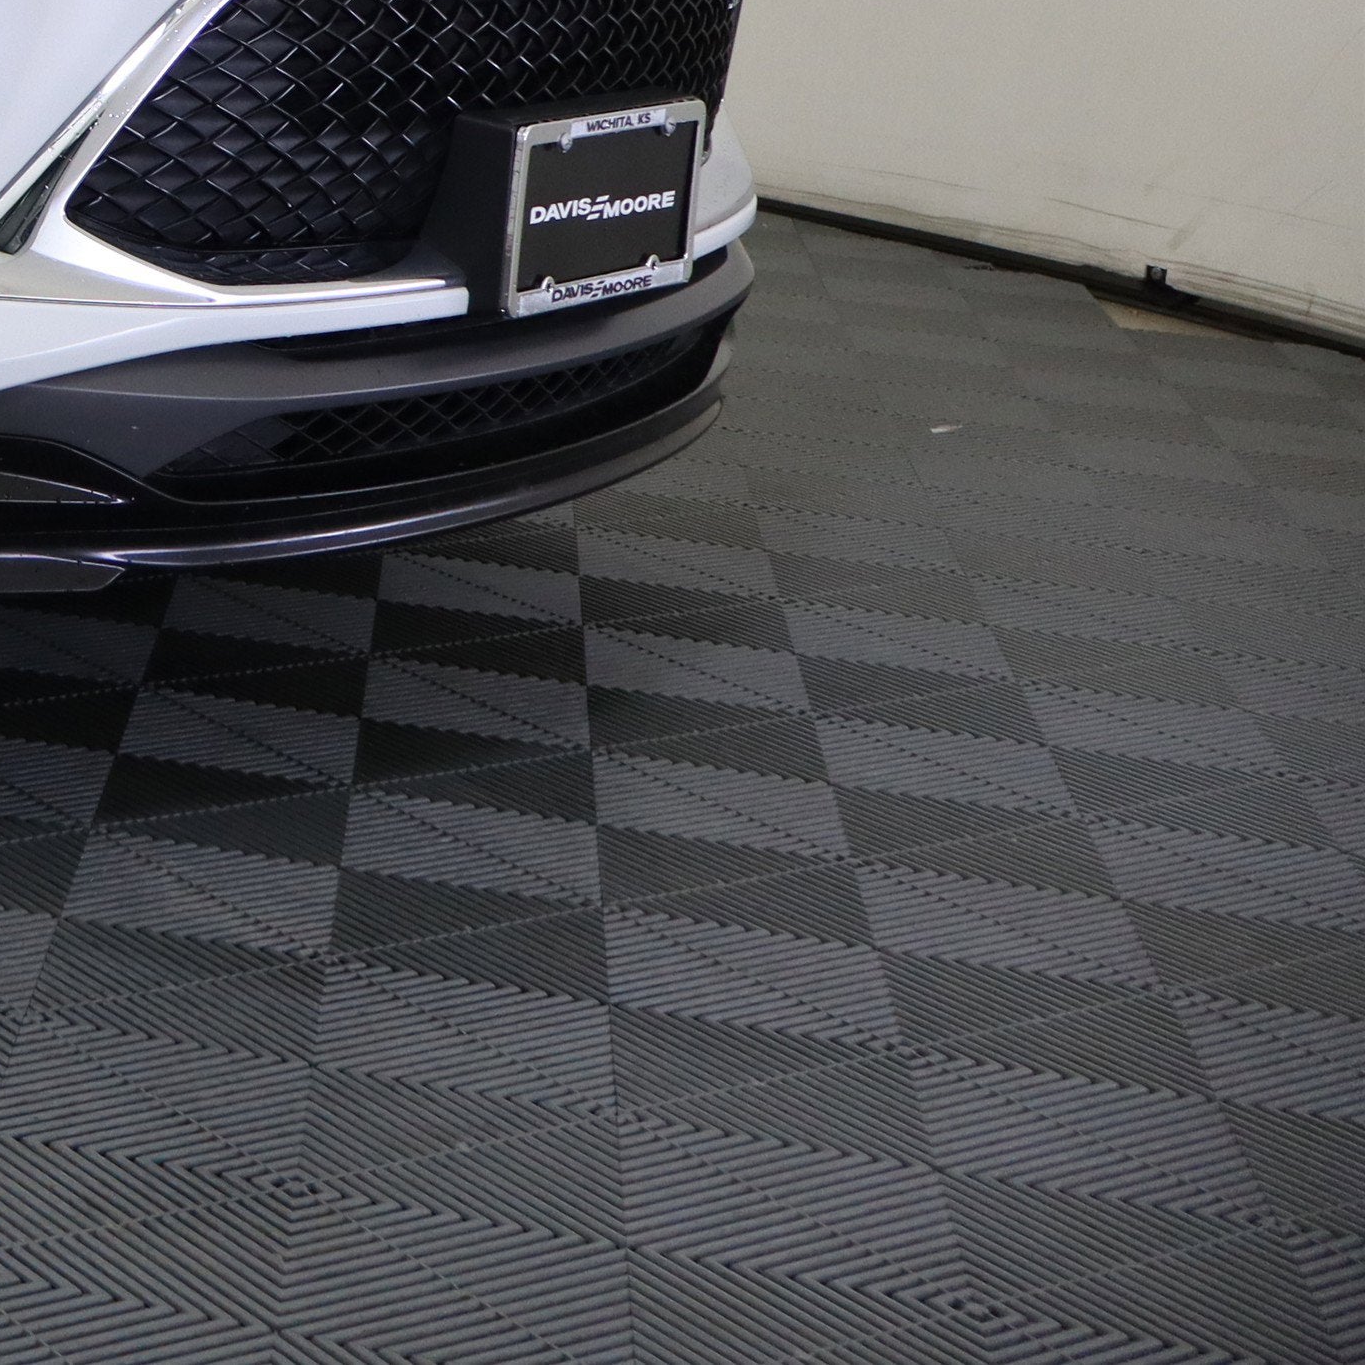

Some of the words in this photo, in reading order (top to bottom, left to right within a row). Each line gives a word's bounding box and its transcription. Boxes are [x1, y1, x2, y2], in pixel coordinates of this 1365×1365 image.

[637, 112, 652, 125] KS
[529, 197, 592, 225] DAVIS
[602, 190, 676, 220] MOORE
[551, 282, 594, 303] DAVIS
[602, 274, 653, 297] MOORE
